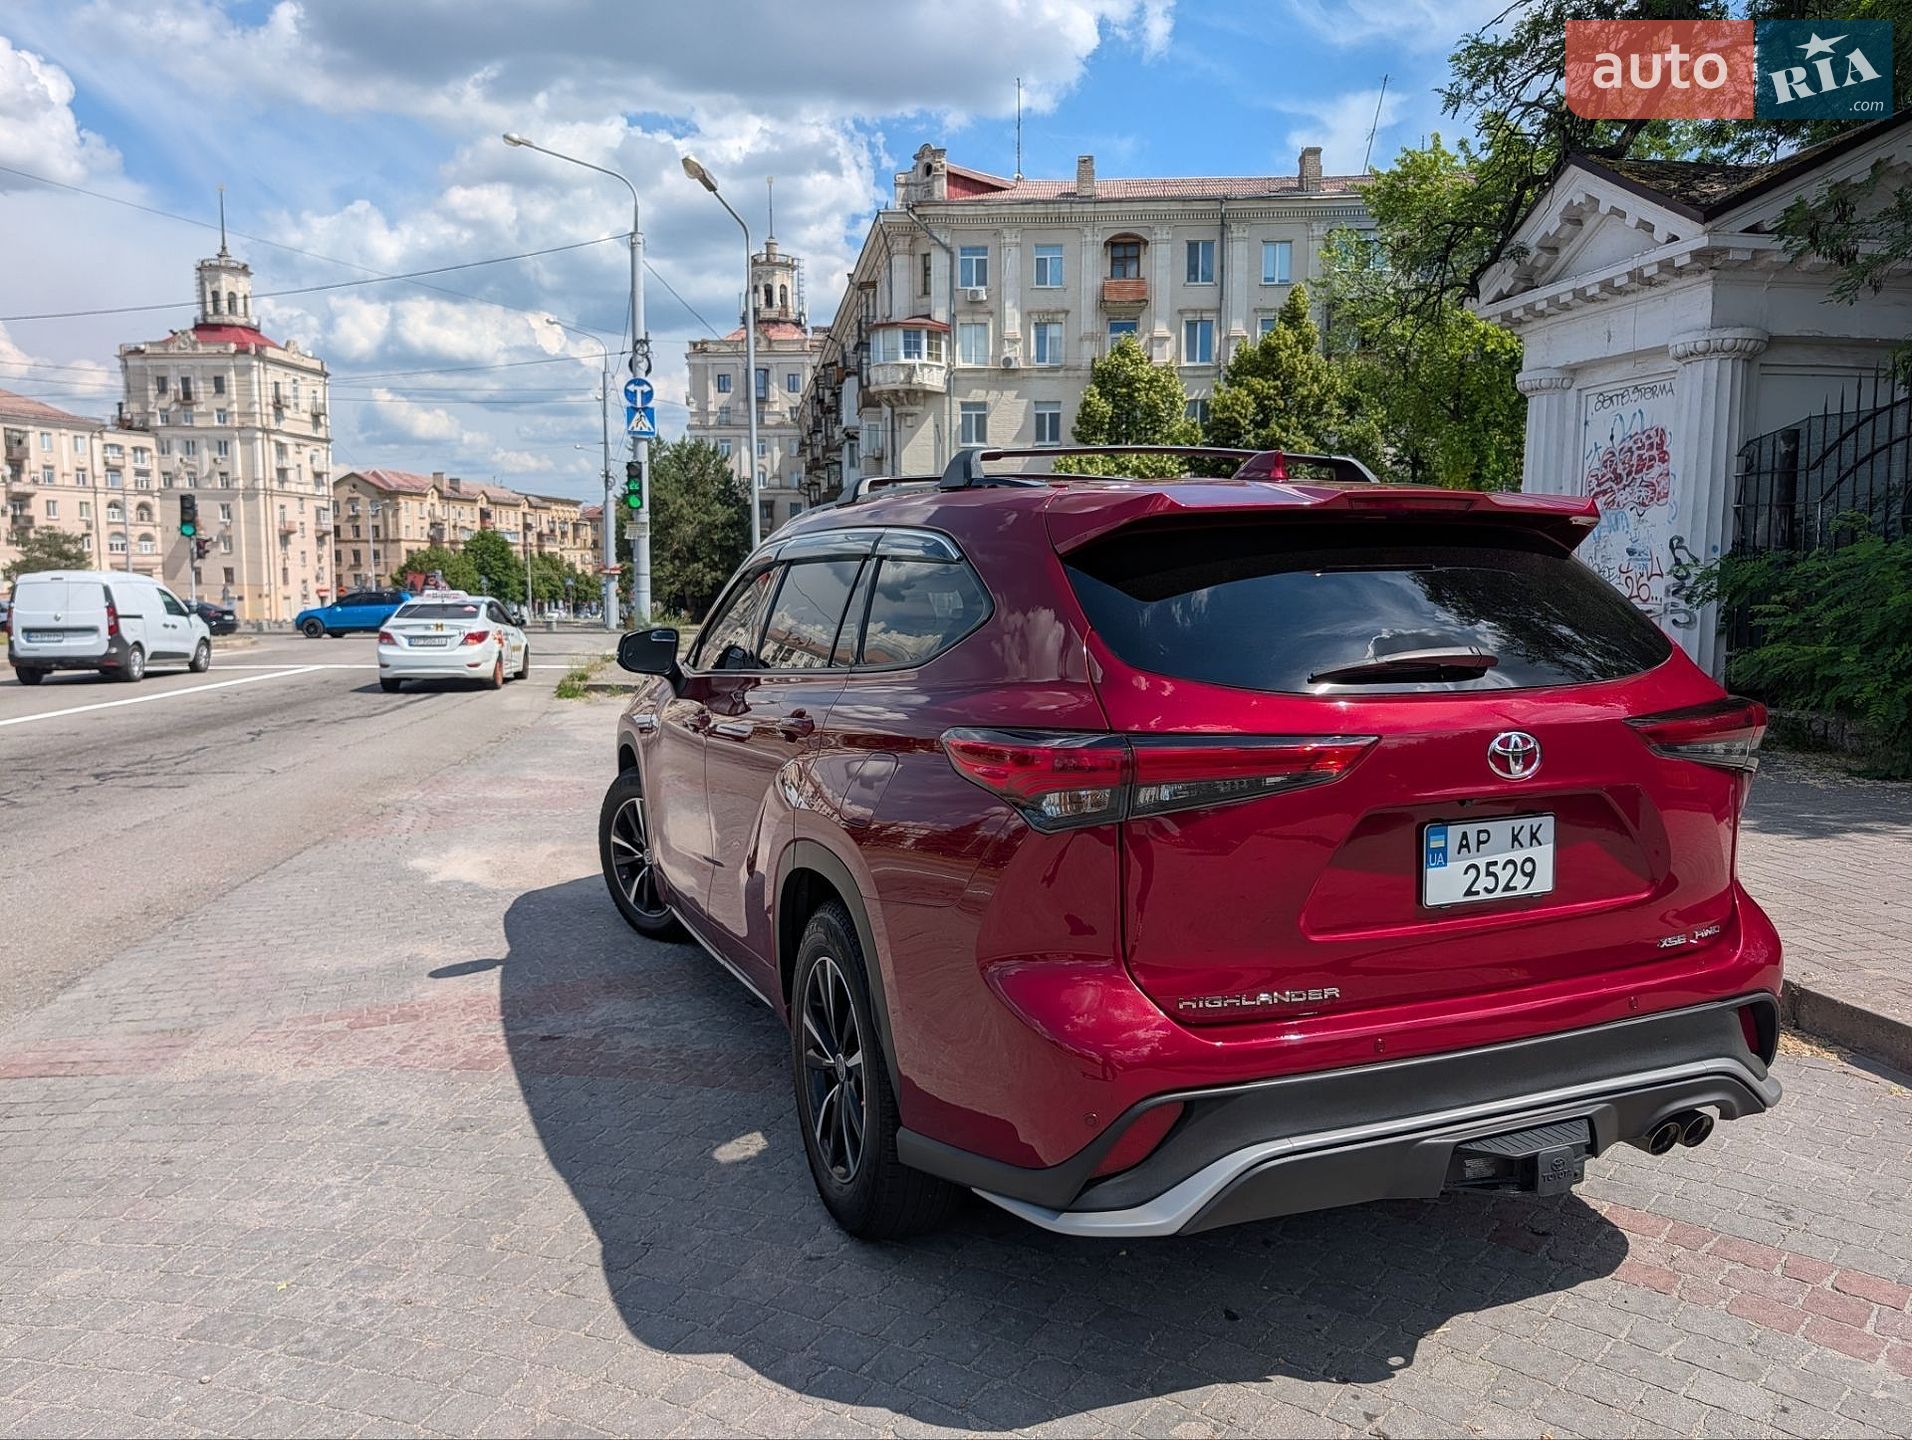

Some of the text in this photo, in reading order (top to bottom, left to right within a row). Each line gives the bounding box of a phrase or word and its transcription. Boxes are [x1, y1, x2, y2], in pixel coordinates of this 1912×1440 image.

[1457, 823, 1544, 855] AP KK
[1428, 852, 1445, 866] UA
[1463, 857, 1537, 897] 2529
[1178, 987, 1341, 1010] HIGHLANDER
